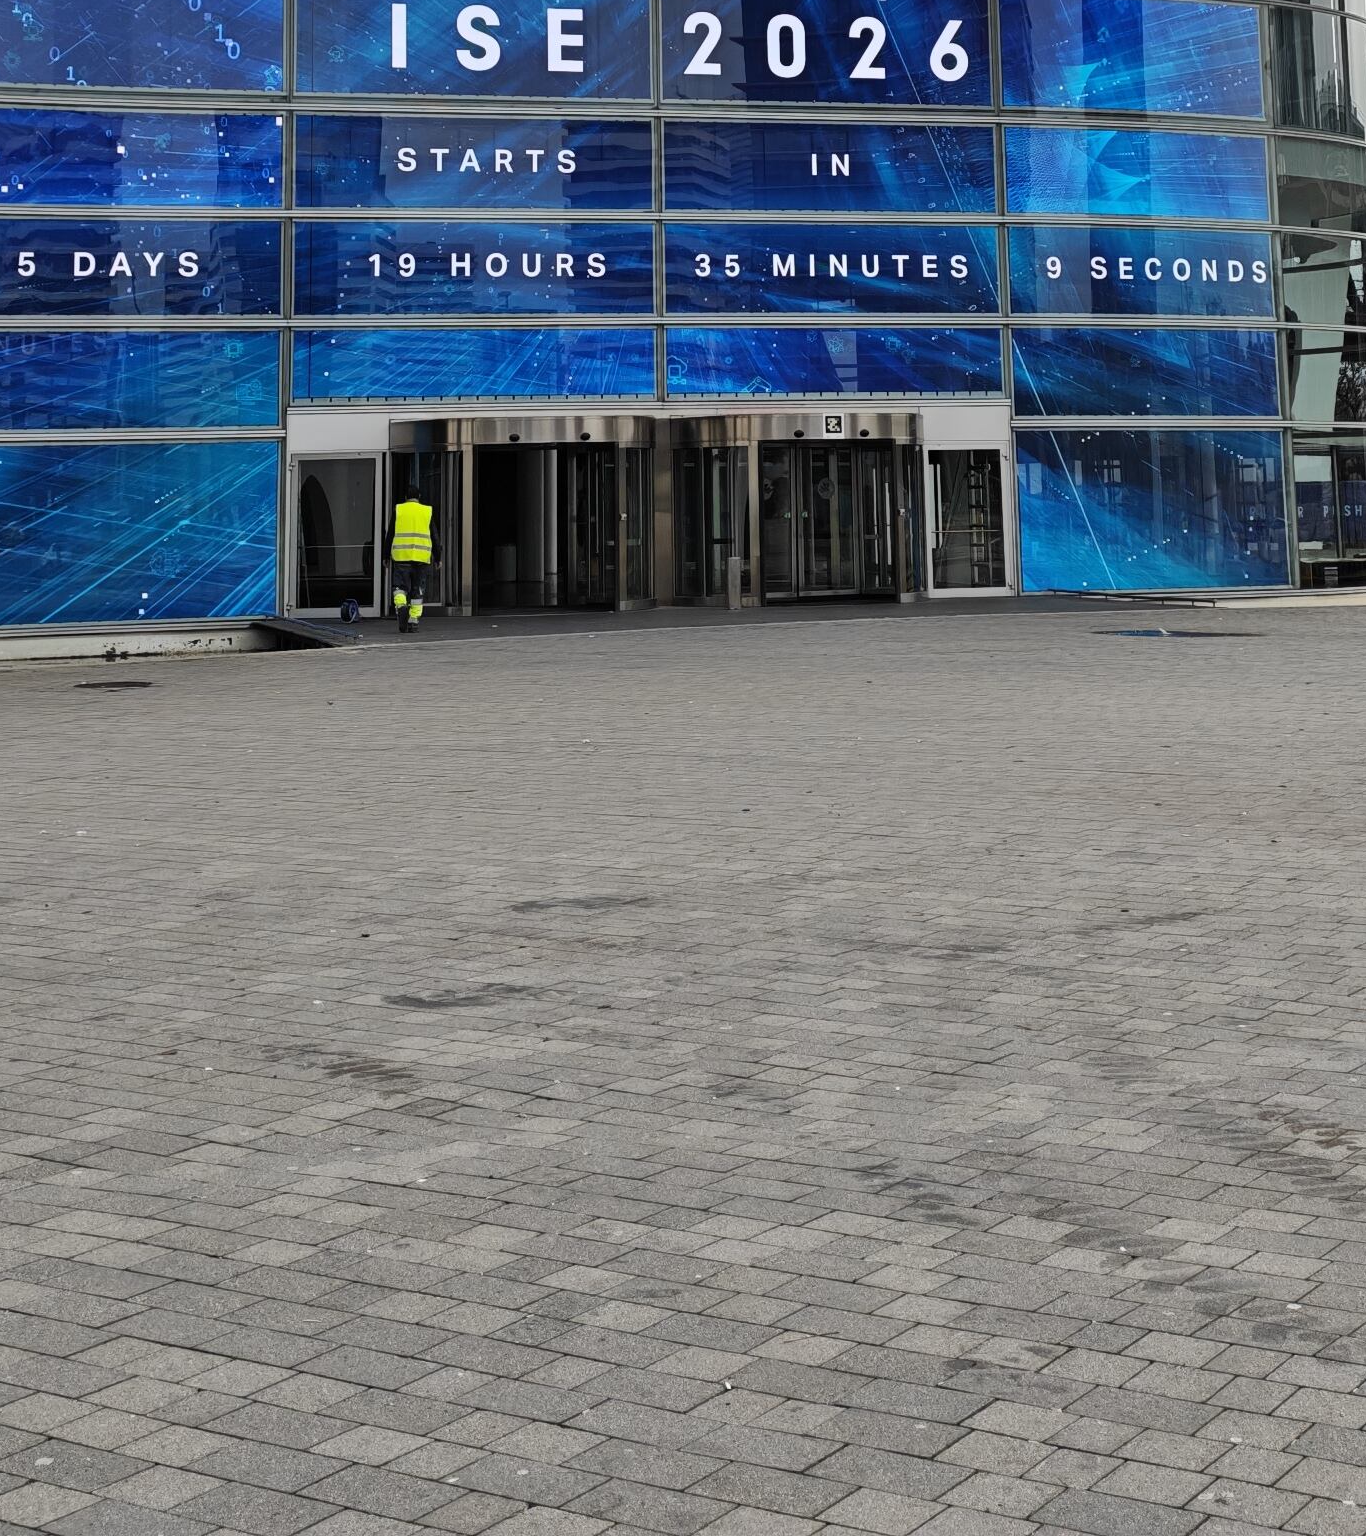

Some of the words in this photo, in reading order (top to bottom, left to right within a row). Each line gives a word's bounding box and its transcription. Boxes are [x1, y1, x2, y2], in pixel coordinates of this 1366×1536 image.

[391, 4, 584, 73] ISE
[683, 11, 969, 83] 2026
[397, 147, 577, 174] STARTS
[811, 153, 851, 177] IN
[17, 251, 36, 277] 5
[73, 251, 199, 278] DAYS
[368, 253, 417, 278] 19
[451, 252, 606, 278] HOURS
[694, 253, 741, 278] 35
[772, 253, 969, 279] MINUTES
[1046, 256, 1062, 279] 9
[1090, 256, 1267, 284] SECONDS
